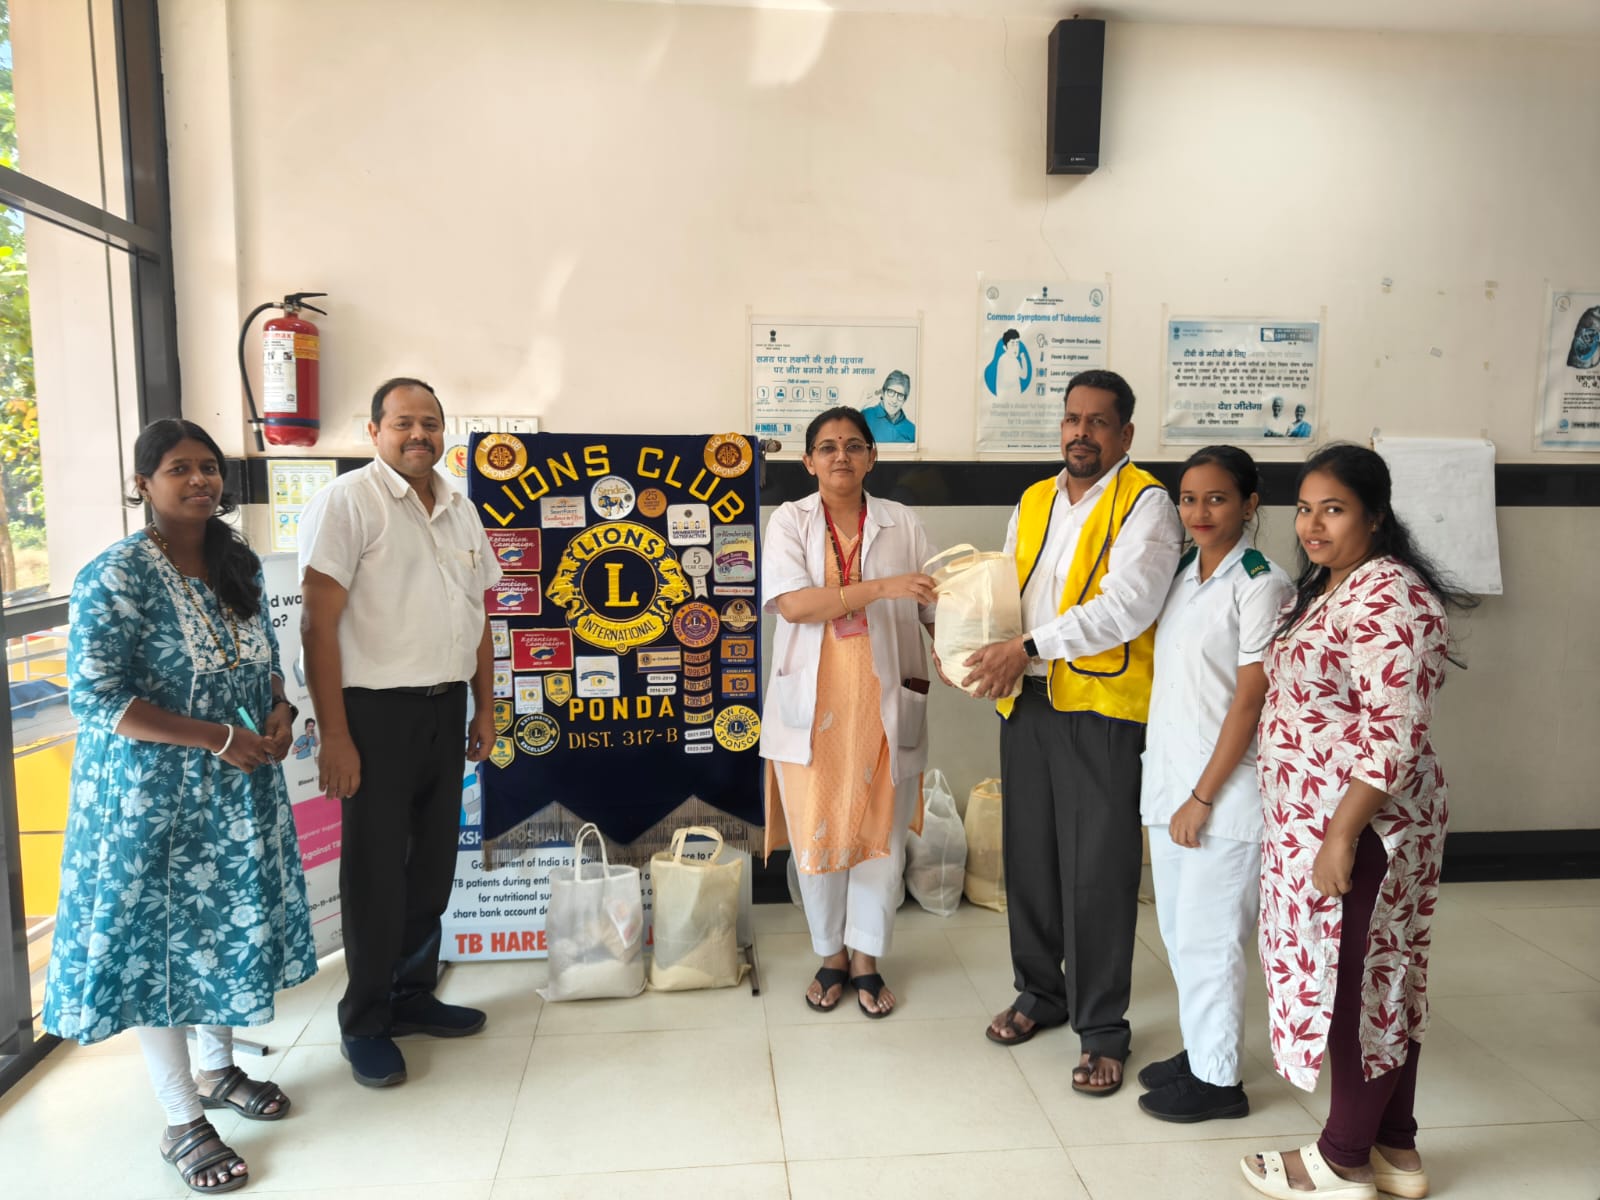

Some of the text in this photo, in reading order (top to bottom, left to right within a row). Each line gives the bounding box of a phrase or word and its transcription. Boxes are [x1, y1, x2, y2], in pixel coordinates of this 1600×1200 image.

[987, 313, 1015, 321] Common
[1017, 313, 1050, 322] Symptoms
[483, 445, 745, 526] LIONS CLUB
[577, 528, 659, 555] LIONS
[693, 552, 701, 564] 5
[604, 563, 639, 607] L
[271, 594, 303, 608] d wa
[272, 613, 288, 628] o?
[583, 618, 657, 641] INTERNATIONAL
[569, 695, 675, 722] PONDA
[716, 707, 759, 728] NEW CLUB
[520, 740, 554, 752] EXCELLENCE
[568, 728, 678, 750] DIST. 317-B
[717, 730, 758, 749] SPONSOR
[458, 831, 481, 845] KSH
[302, 845, 331, 860] Against
[527, 858, 536, 867] of
[538, 857, 560, 867] India
[562, 857, 569, 866] is
[453, 876, 550, 890] TB patients during enti
[478, 892, 491, 903] for
[493, 891, 537, 902] nutritional
[453, 909, 477, 919] share
[480, 908, 501, 918] bank
[504, 907, 537, 917] account
[455, 930, 549, 954] TB HARE
